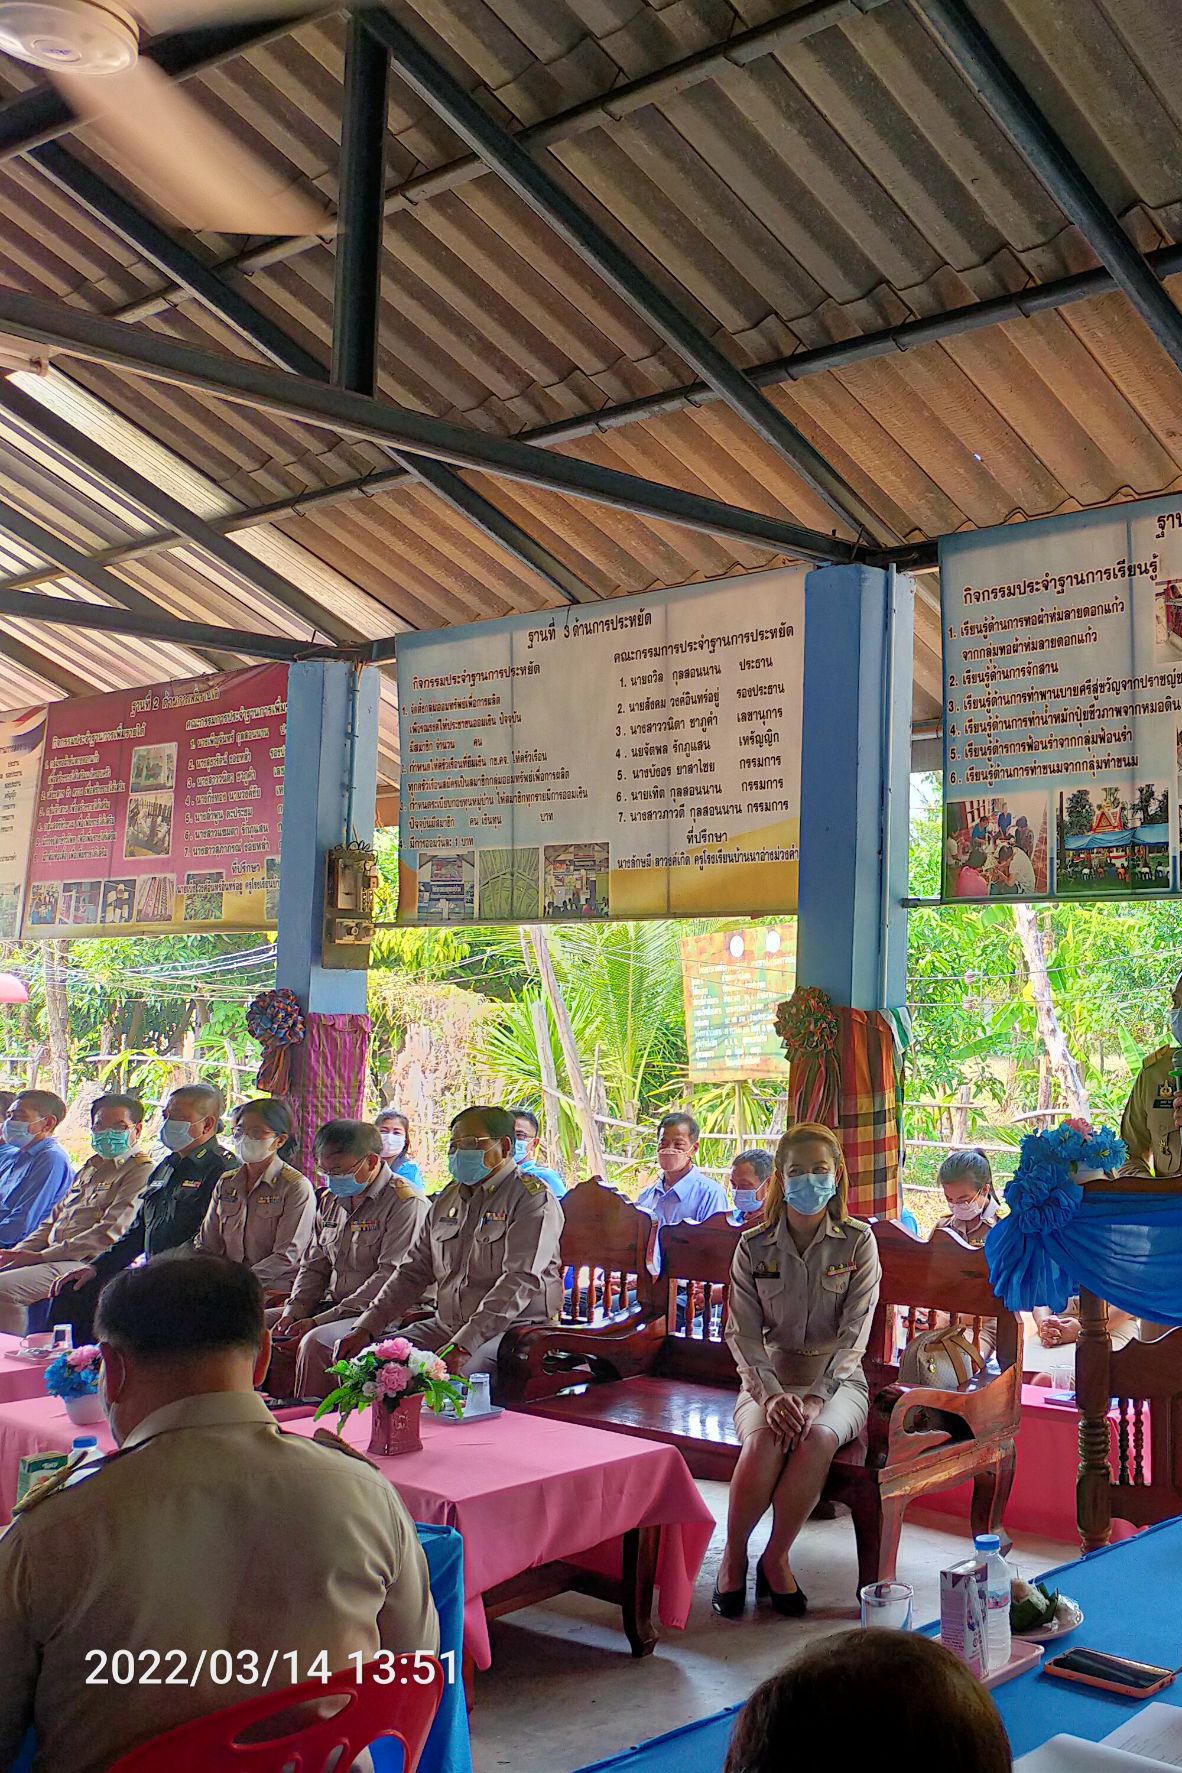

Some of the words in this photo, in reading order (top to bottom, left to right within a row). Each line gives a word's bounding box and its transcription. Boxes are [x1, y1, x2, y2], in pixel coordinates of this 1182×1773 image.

[963, 553, 1159, 606] กิจกรรมประจำฐานการเรียนรู้
[527, 616, 556, 649] ฐานที่
[572, 608, 651, 637] ด้านการประหยัด
[949, 626, 957, 639] 1.
[614, 621, 794, 663] คณะกรรมการประจำฐานการประหยัด
[620, 677, 627, 688] 1.
[630, 670, 664, 686] นายถวิล
[672, 663, 721, 687] กุลสอนนาน
[739, 656, 773, 672] ประธาน
[949, 675, 958, 688] 2.
[962, 660, 1059, 690] เรียนรู้ด้านการจักสาน
[153, 696, 159, 711] 2
[618, 704, 625, 714] 2.
[629, 696, 666, 713] นายสังคม
[737, 682, 785, 699] รองประธาน
[737, 707, 783, 726] เลขานุการ
[739, 730, 779, 747] เหรัญญิก
[632, 763, 672, 780] นางบังอร
[739, 755, 782, 769] กรรมการ
[670, 783, 722, 805] กุลสอนนาน
[741, 777, 783, 793] กรรมการ
[618, 812, 626, 823] 7.
[690, 801, 742, 824] กุลสอนนาน
[747, 799, 789, 814] กรรมการ
[687, 826, 728, 845] ที่ปรึกษา
